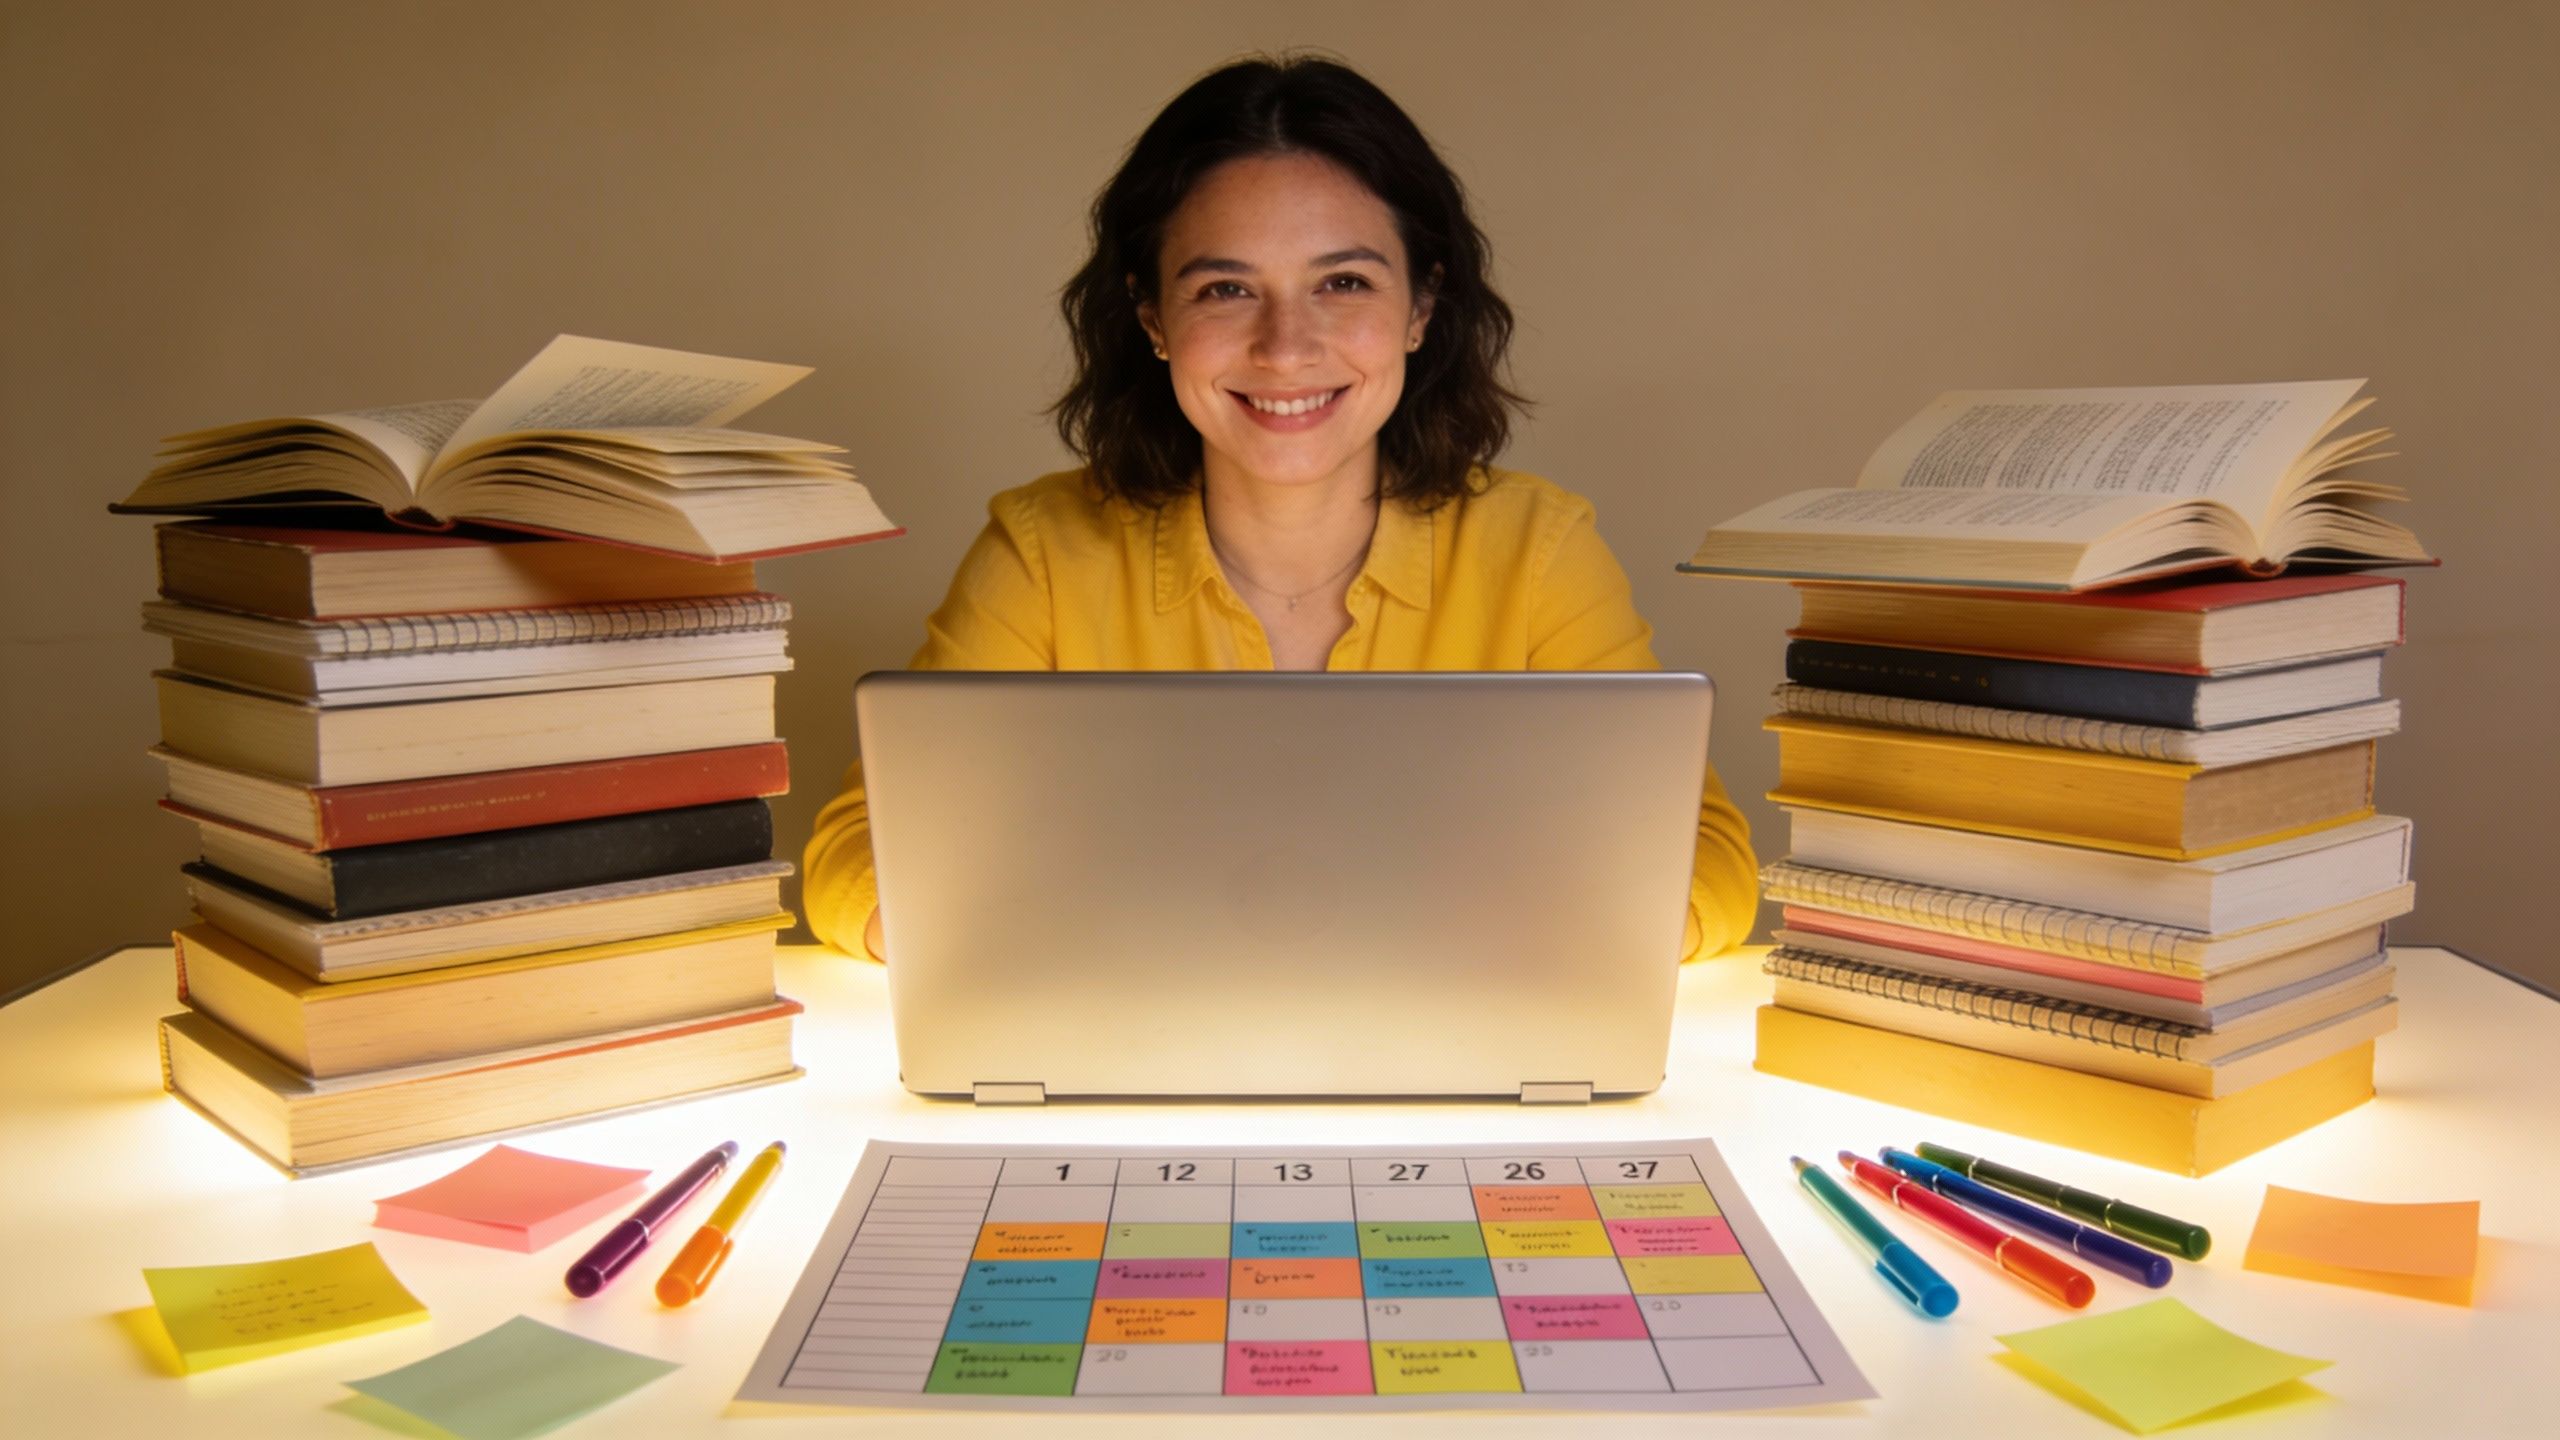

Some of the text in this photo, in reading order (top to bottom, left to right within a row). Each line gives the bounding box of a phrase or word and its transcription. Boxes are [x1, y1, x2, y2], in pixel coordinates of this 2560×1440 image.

[1056, 1163, 1071, 1182] 1
[1158, 1163, 1197, 1182] 12
[1275, 1164, 1314, 1182] 13
[1388, 1163, 1429, 1181] 27
[1504, 1162, 1546, 1181] 26
